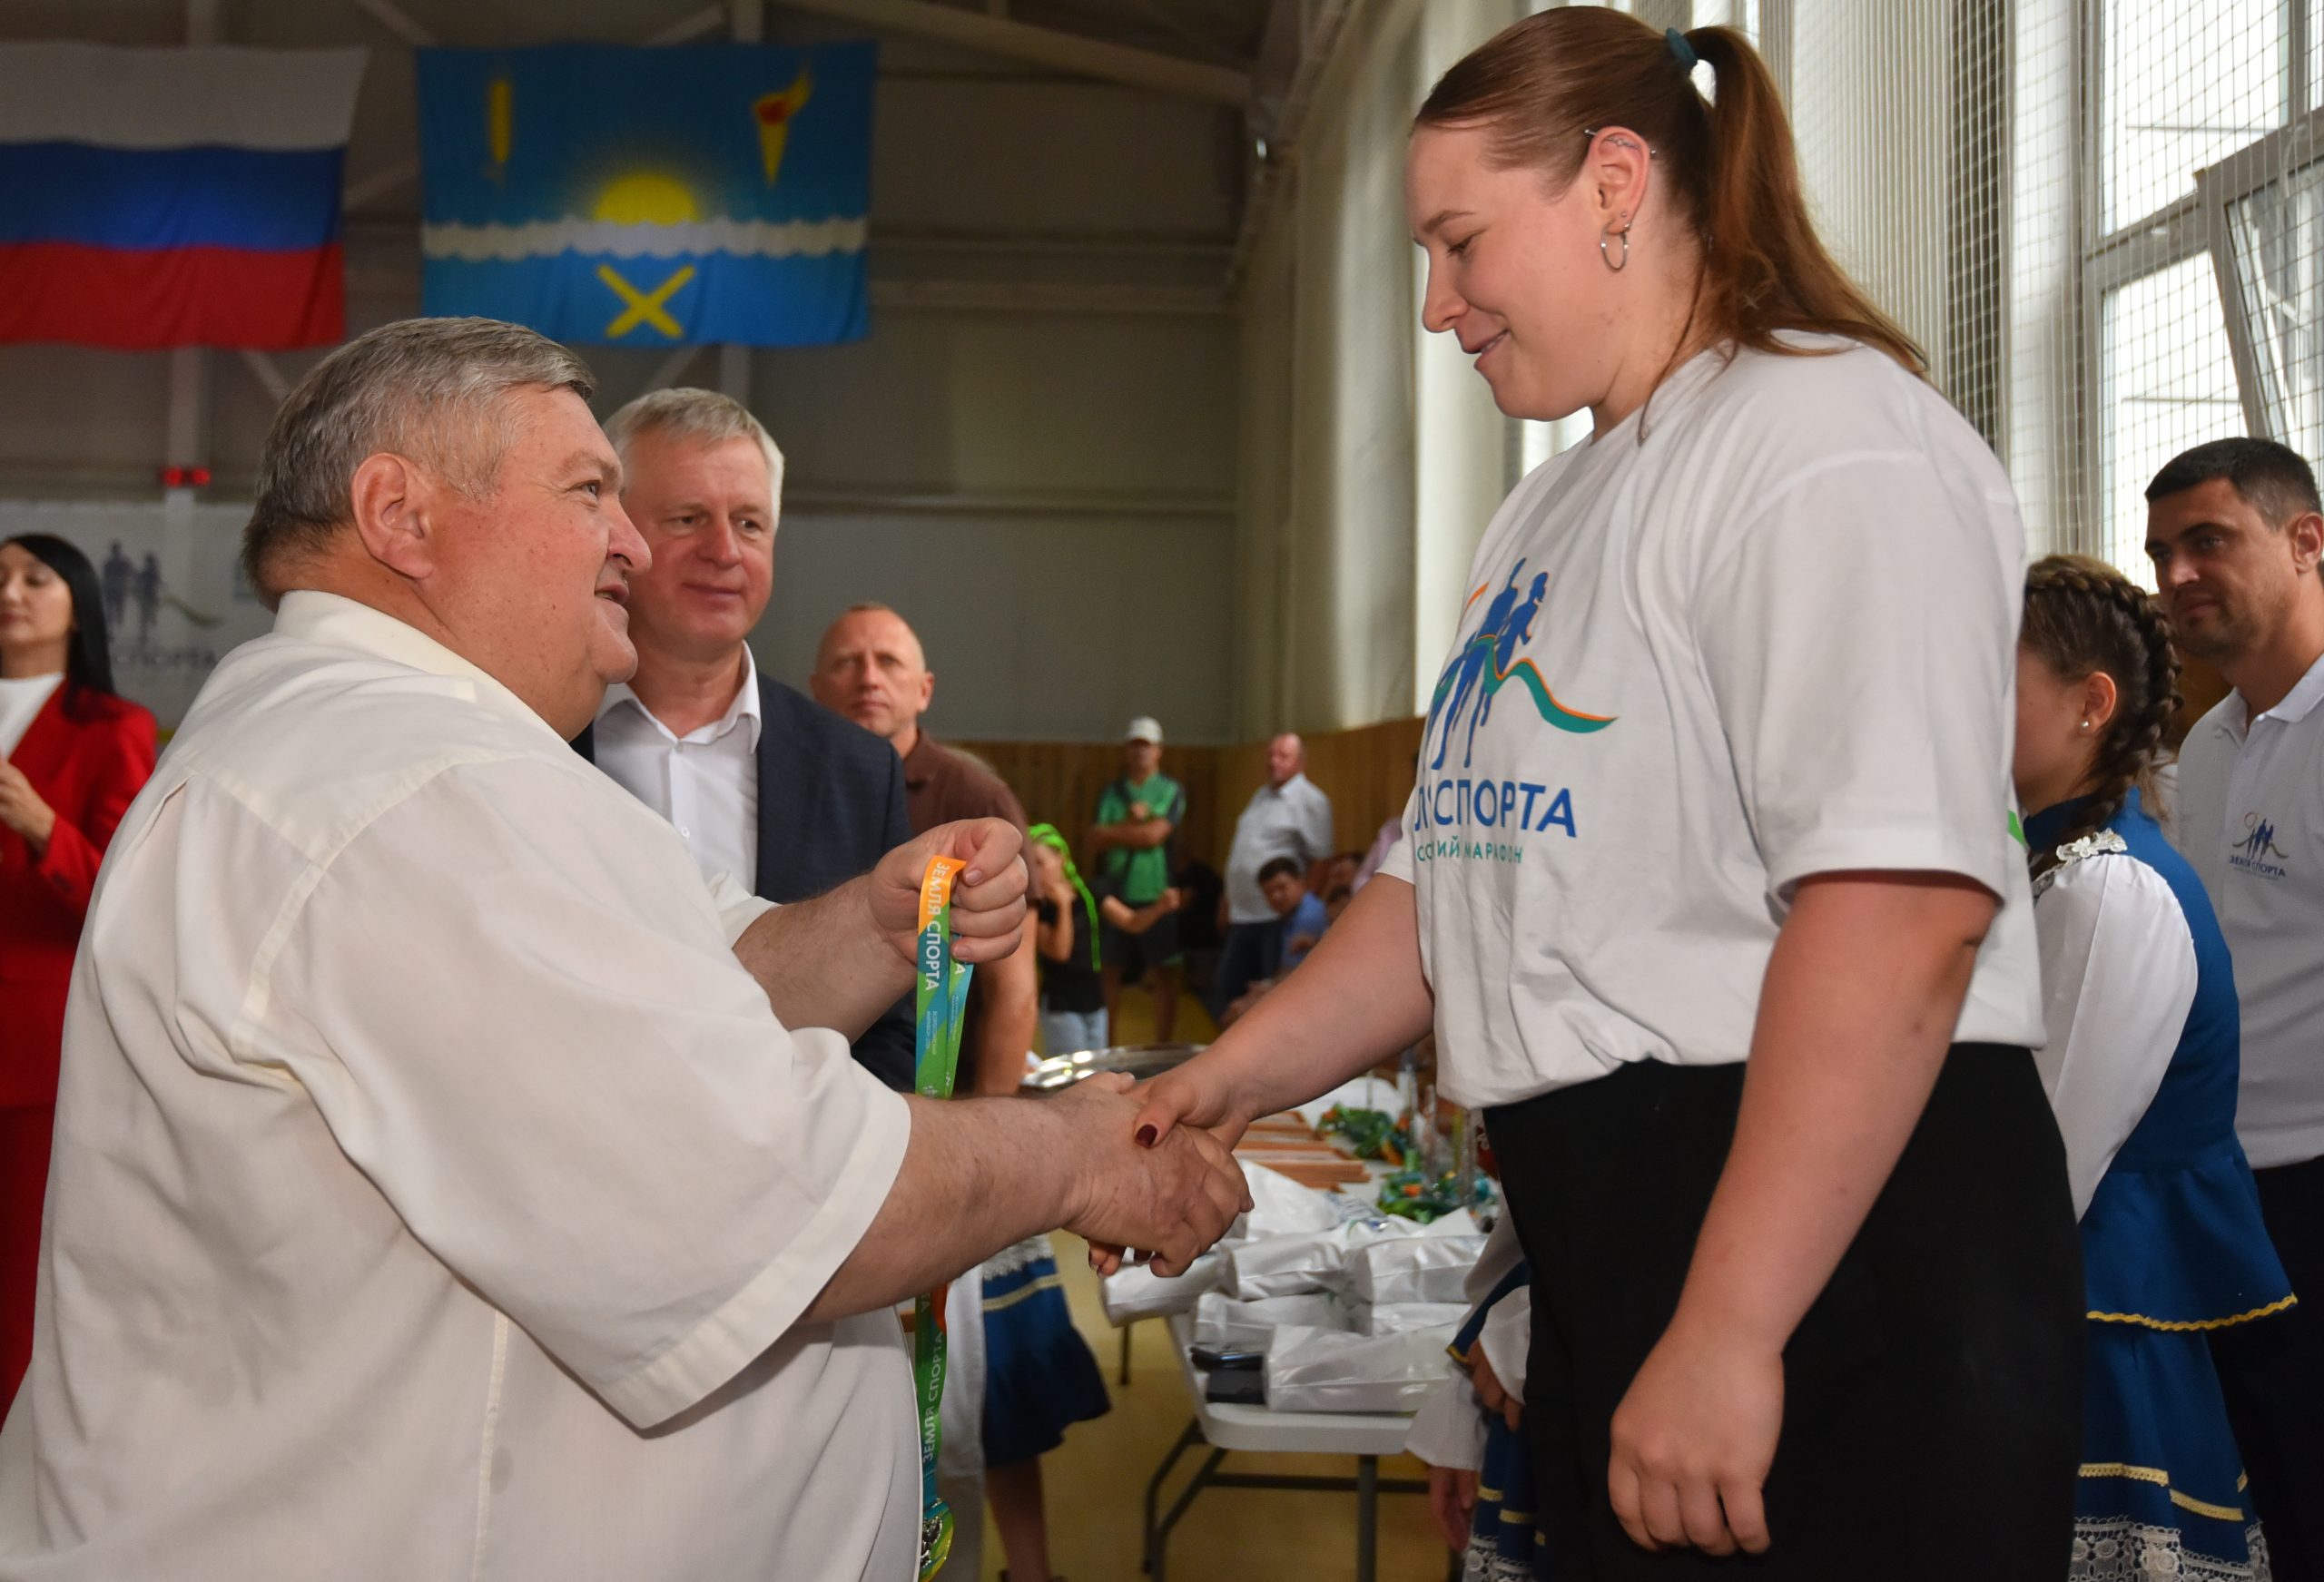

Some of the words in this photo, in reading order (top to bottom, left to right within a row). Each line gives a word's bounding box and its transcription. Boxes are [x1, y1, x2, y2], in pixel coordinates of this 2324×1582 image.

[1433, 779, 1578, 838] СПОРТА
[927, 861, 950, 916] ЗЕМЛЯ
[925, 919, 941, 991] СПОРТА
[928, 1331, 943, 1402] СПОРТА
[922, 1406, 936, 1463] ЗЕМЛЯ
